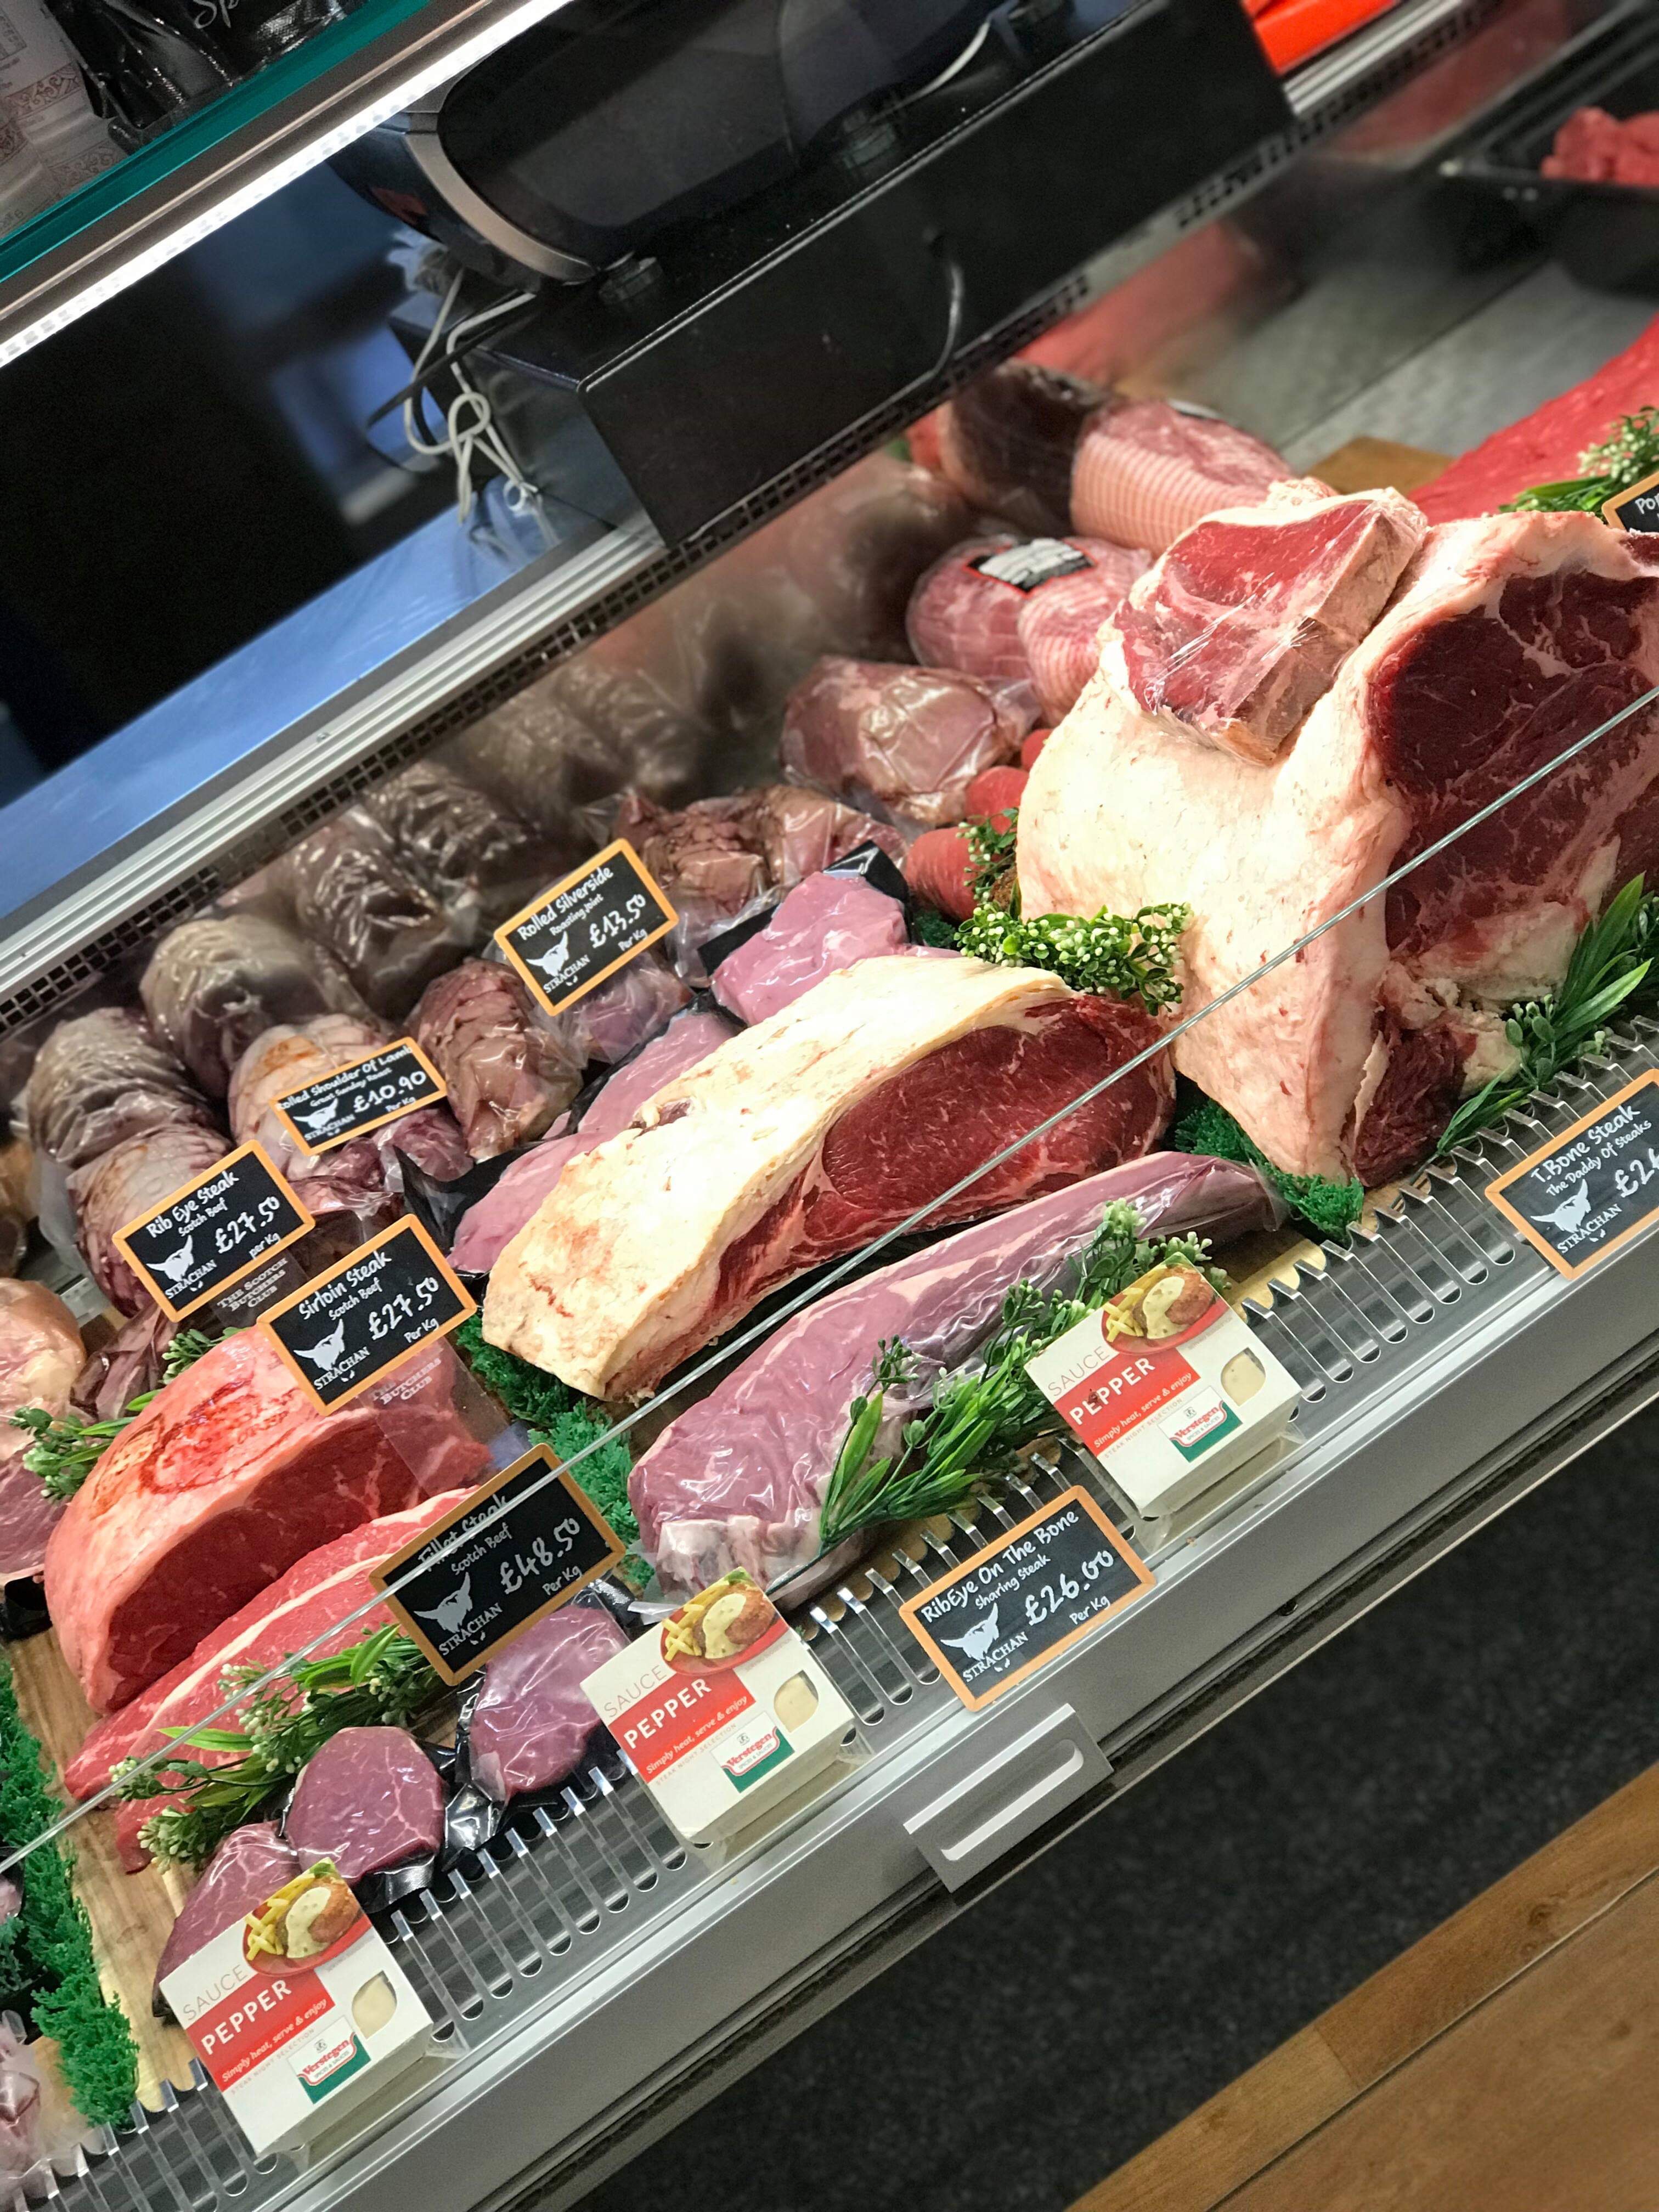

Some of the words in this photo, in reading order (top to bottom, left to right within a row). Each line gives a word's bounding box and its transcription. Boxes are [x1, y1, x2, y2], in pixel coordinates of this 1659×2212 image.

[517, 904, 557, 940] Rolled
[556, 866, 613, 913] Silverside
[550, 910, 586, 935] Roasting
[584, 893, 604, 913] Joint
[589, 894, 646, 948] £13.50
[618, 936, 633, 951] Per
[632, 928, 648, 940] Kg
[543, 955, 591, 993] STRACHAN
[310, 1093, 335, 1107] Great
[335, 1079, 366, 1096] Sunday
[367, 1067, 392, 1082] Roast
[311, 1069, 360, 1096] Shoulder
[362, 1059, 377, 1073] Of
[377, 1045, 413, 1064] Lamb
[353, 1071, 426, 1113] £10.90
[304, 1114, 356, 1141] STRACHAN
[385, 1102, 401, 1113] Per
[400, 1096, 416, 1107] Kg
[1531, 1142, 1590, 1183] T.Bone
[1588, 1104, 1641, 1144] Steak
[1546, 1176, 1569, 1197] The
[1565, 1156, 1601, 1182] Daddy
[1600, 1144, 1618, 1159] Of
[146, 1214, 172, 1238] Rib
[172, 1199, 199, 1223] Eye
[197, 1170, 239, 1204] Steak
[178, 1212, 207, 1237] Scotch
[205, 1197, 228, 1217] Beef
[215, 1196, 280, 1254] £27.50
[1557, 1204, 1622, 1254] STRACHAN
[266, 1232, 281, 1245] Kg
[165, 1260, 217, 1299] STRACHAN
[298, 1281, 347, 1320] Sirloin
[346, 1249, 392, 1288] Steak
[329, 1295, 360, 1321] Scotch
[358, 1277, 383, 1300] Beef
[368, 1277, 439, 1341] £27.50
[404, 1327, 422, 1343] Per
[421, 1317, 439, 1333] Kg
[313, 1346, 370, 1390] STRACHAN
[1048, 1346, 1110, 1397] SAUCE
[1069, 1357, 1155, 1425] PEPPER
[1094, 1423, 1121, 1449] Simply
[1120, 1410, 1142, 1428] heat,
[1141, 1394, 1163, 1413] serve
[1161, 1387, 1172, 1397] &
[1170, 1372, 1193, 1391] enjoy
[1103, 1441, 1125, 1458] STEAK
[1125, 1425, 1146, 1442] NIGHT
[1146, 1398, 1183, 1426] SELECTION
[1175, 1404, 1220, 1440] Verstegen
[451, 1545, 486, 1576] Scotch
[484, 1522, 512, 1549] Beef
[500, 1518, 580, 1594] £48.50
[921, 1579, 978, 1623] RibEye
[978, 1564, 1004, 1584] On
[1002, 1541, 1037, 1565] The
[1034, 1511, 1079, 1544] Bone
[542, 1576, 564, 1596] Per
[564, 1566, 583, 1581] Kg
[1025, 1550, 1114, 1626] £26.00
[439, 1602, 503, 1656] STRACHAN
[1069, 1607, 1090, 1625] Per
[1090, 1595, 1111, 1611] Kg
[963, 1632, 1029, 1683] STRACHAN
[603, 1665, 667, 1718] SAUCE
[623, 1678, 712, 1750] PEPPER
[646, 1748, 674, 1775] Simply
[673, 1734, 695, 1753] heat,
[695, 1717, 716, 1738] serve
[716, 1711, 725, 1721] &
[723, 1696, 748, 1715] enjoy
[726, 1733, 772, 1769] Verstegen
[183, 1964, 248, 2021] SAUCE
[201, 1979, 292, 2055] PEPPER
[222, 2057, 250, 2082] Simply
[249, 2041, 273, 2061] heat,
[273, 2023, 295, 2043] serve
[295, 2015, 304, 2027] &
[302, 1999, 328, 2020] enjoy
[301, 2039, 350, 2076] Verstegen
